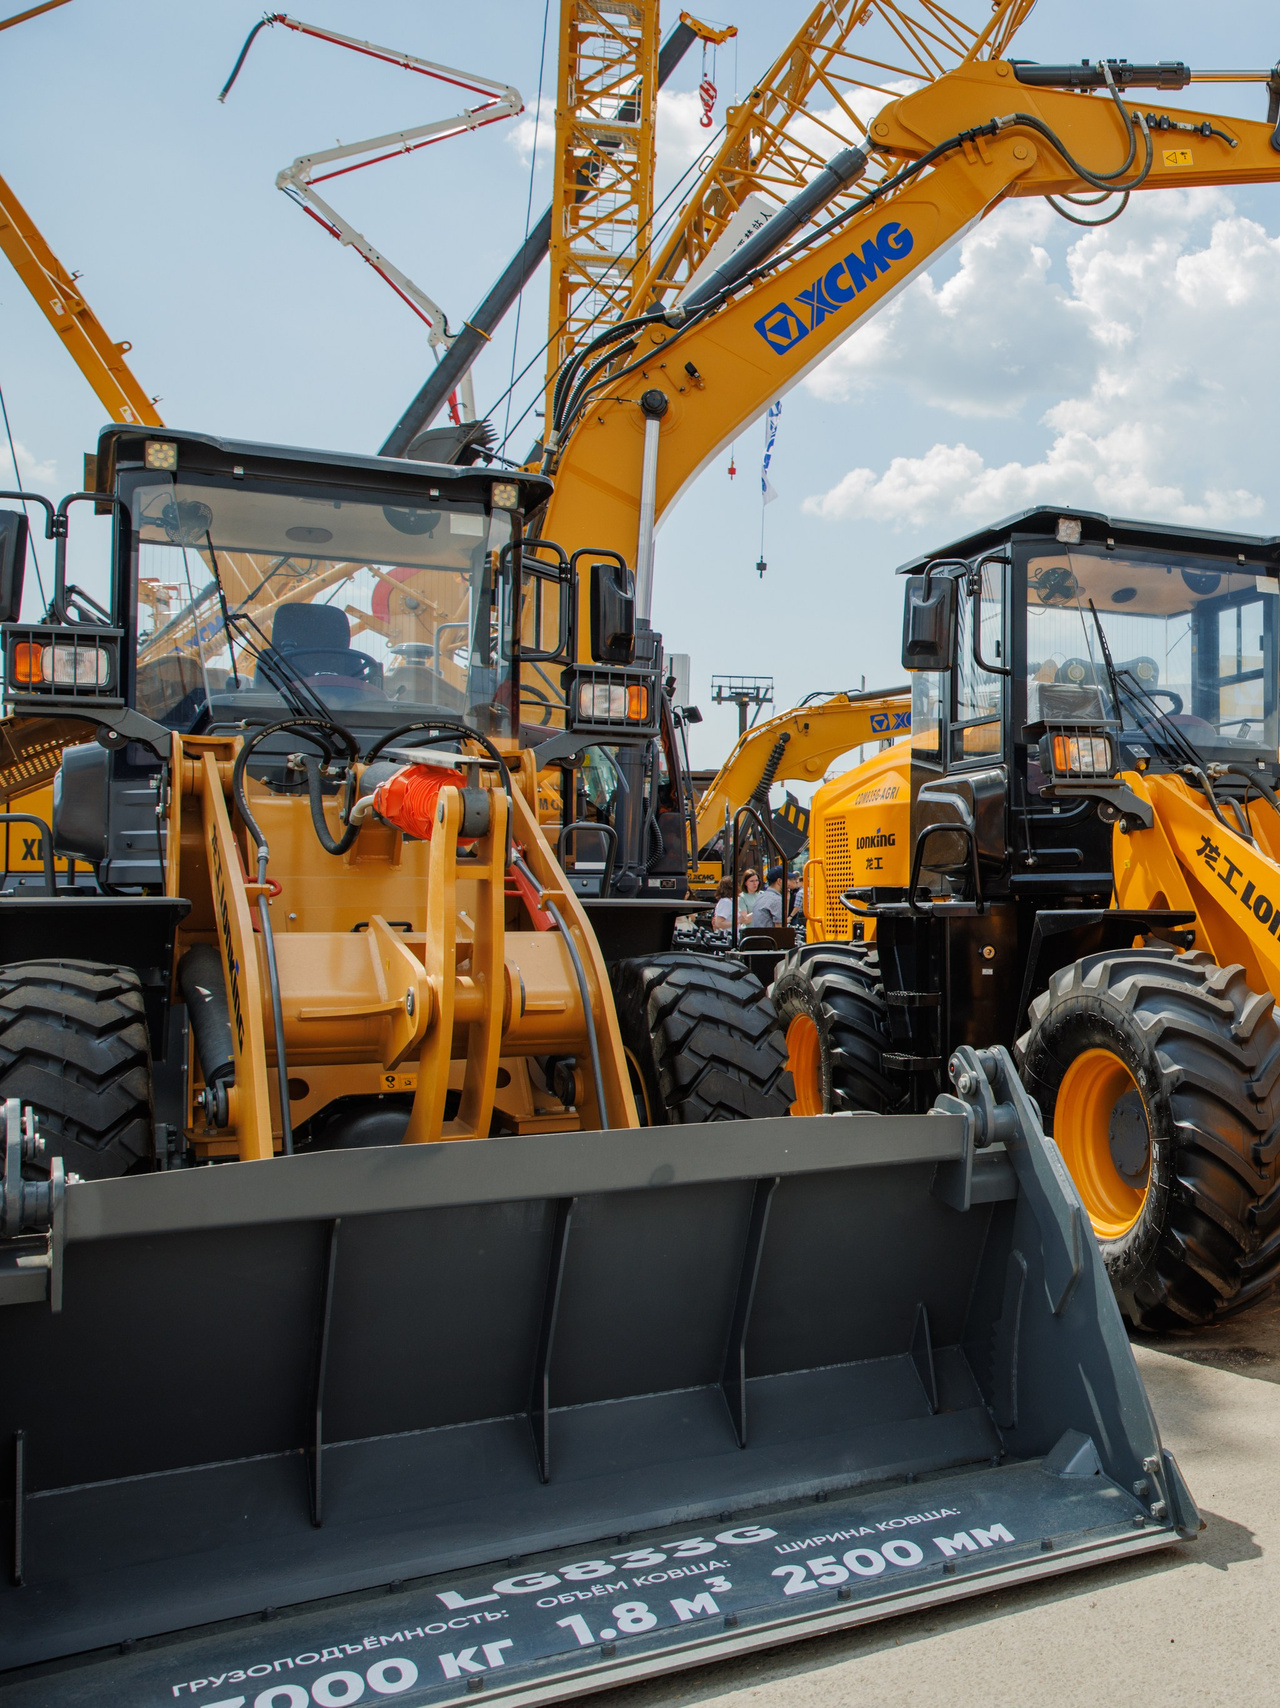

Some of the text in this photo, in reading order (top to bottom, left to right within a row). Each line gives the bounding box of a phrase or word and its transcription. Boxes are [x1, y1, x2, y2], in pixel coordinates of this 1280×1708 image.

[793, 221, 914, 332] XCMG
[1195, 834, 1244, 896] 龙工
[774, 1507, 962, 1554] ШИРИНА КОВША:
[435, 1524, 779, 1610] LG833G
[536, 1558, 732, 1609] ОБЪЁМ КОВША:
[771, 1538, 924, 1596] 2500
[171, 1608, 511, 1698] ГРУЗОПОДЪЁМНОСТЬ:
[556, 1600, 658, 1646] 1.8
